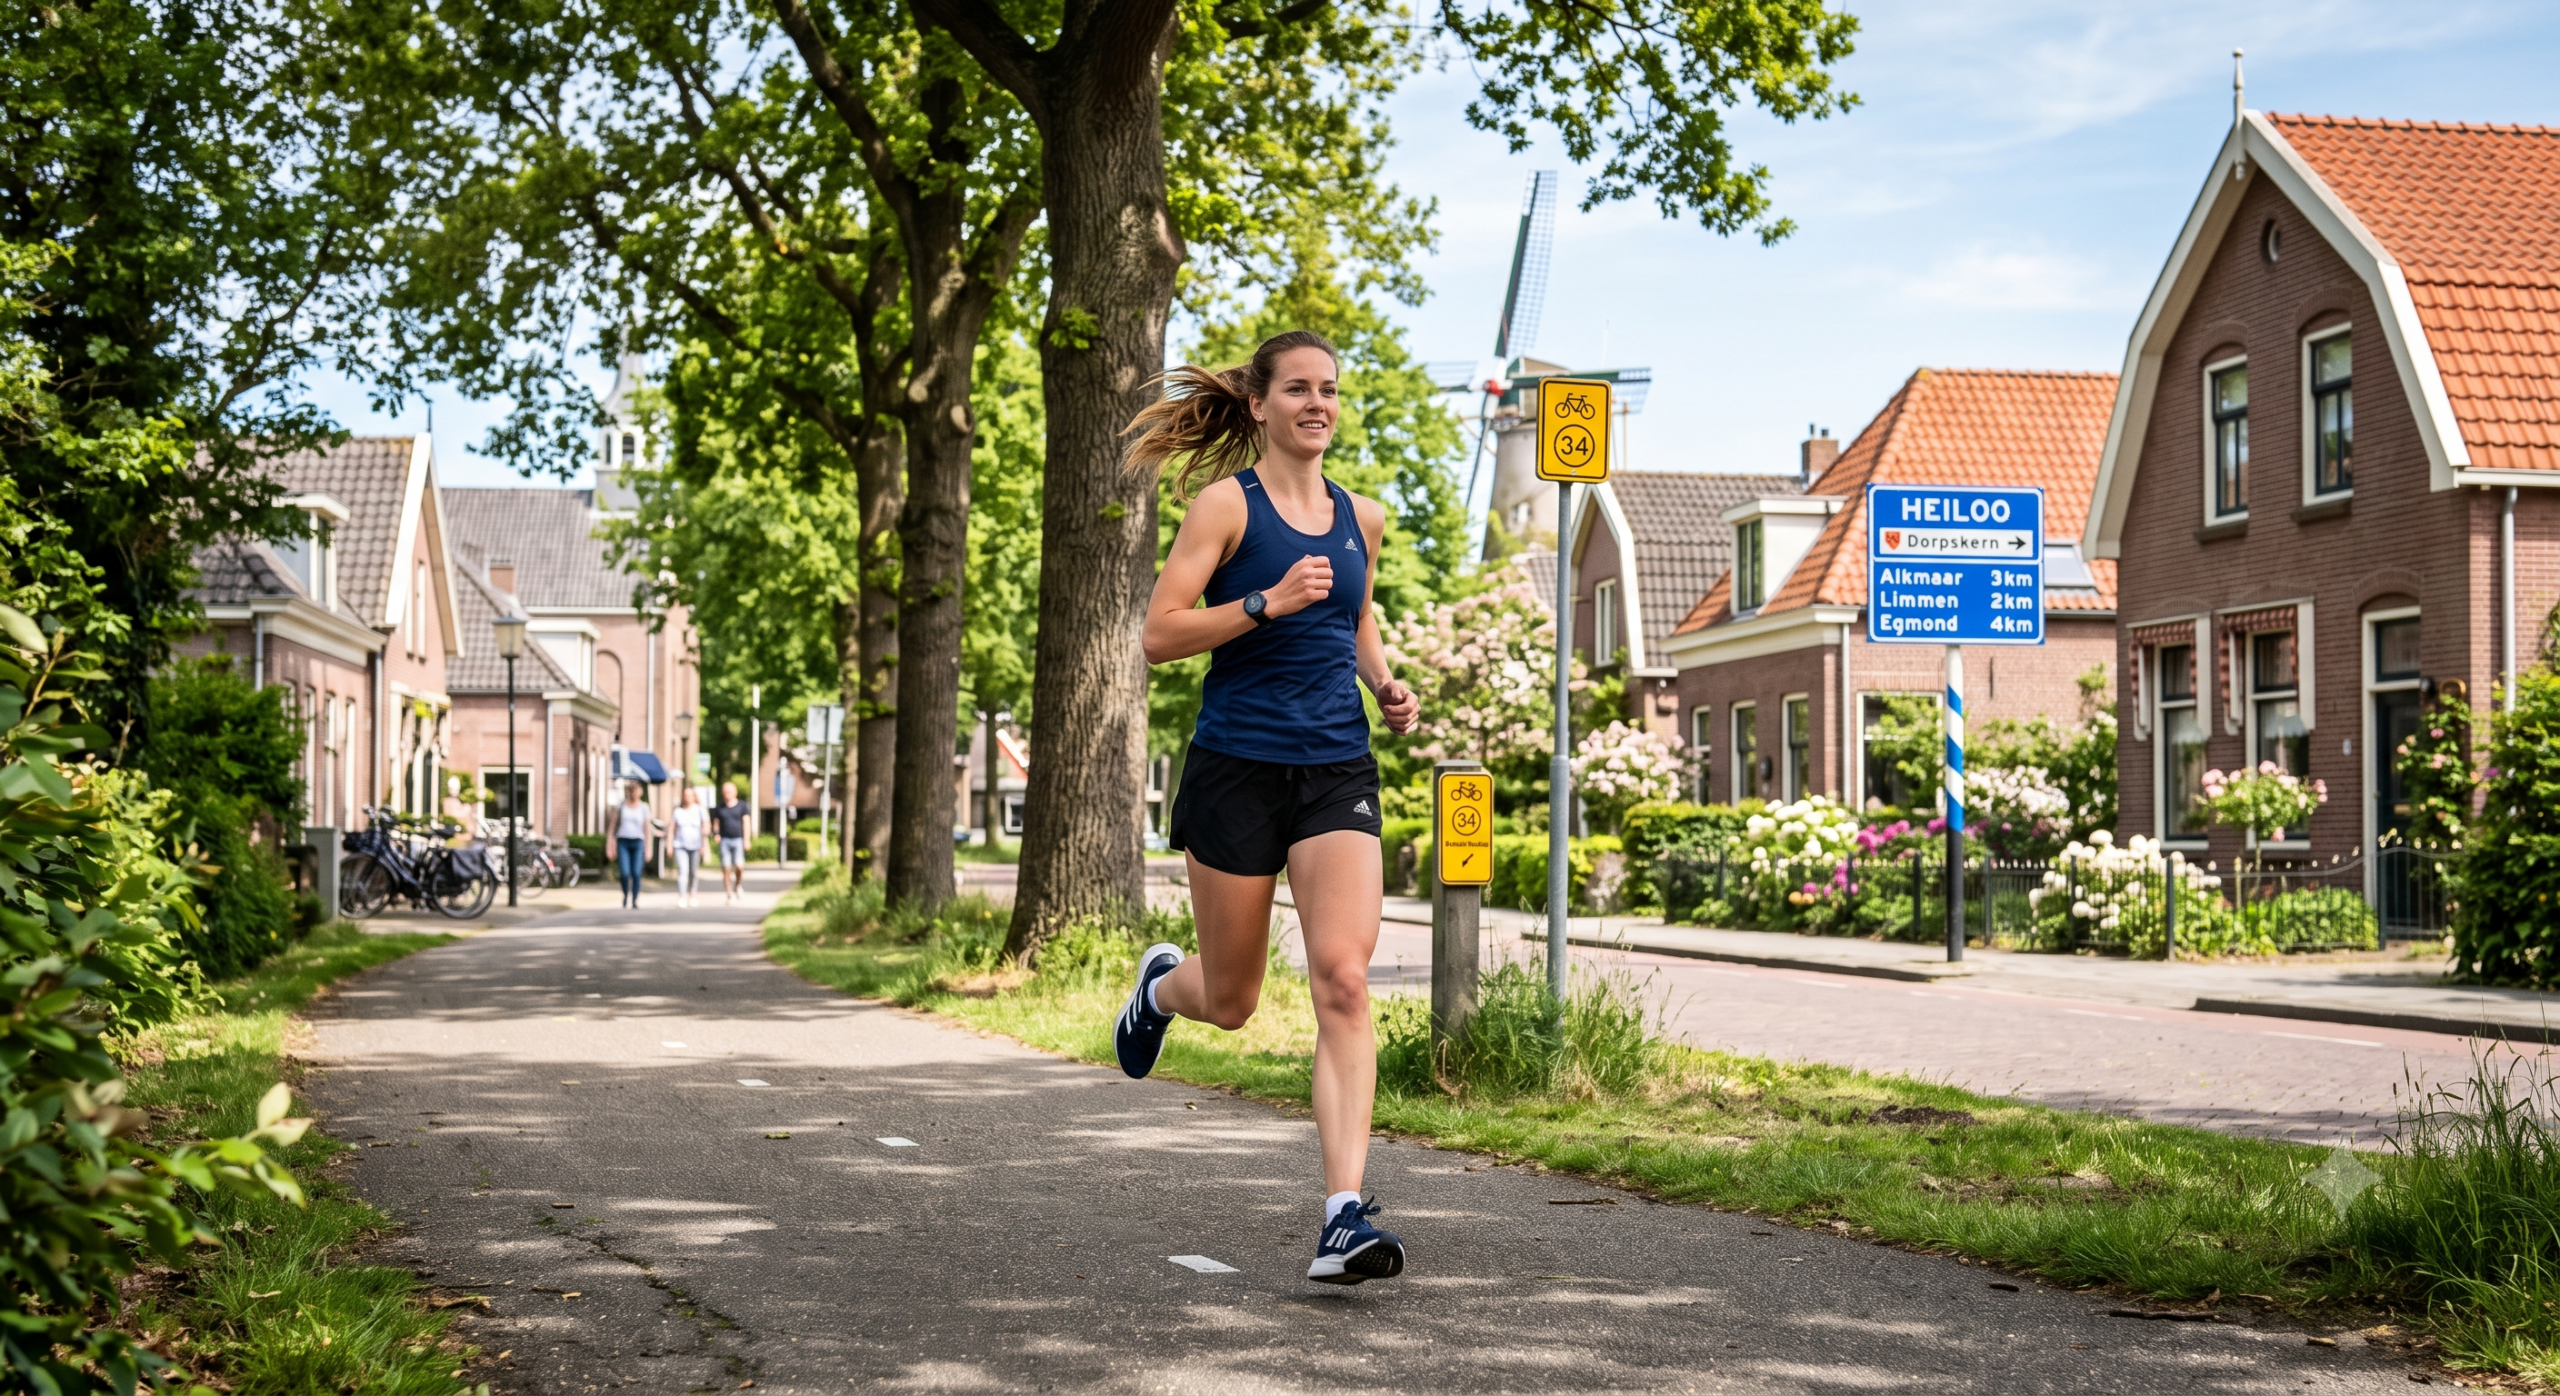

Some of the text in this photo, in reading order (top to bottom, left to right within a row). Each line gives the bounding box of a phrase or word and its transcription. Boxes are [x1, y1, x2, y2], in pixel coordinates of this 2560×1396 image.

[1561, 435, 1588, 456] 34
[1902, 497, 2011, 523] HEILOO
[1908, 534, 1999, 551] Dorpskern
[1880, 567, 2033, 587] Alkmaar 3km
[1880, 590, 2033, 610] Limmen 2km
[1880, 613, 2033, 636] Egmond 4km
[1457, 812, 1476, 828] 34
